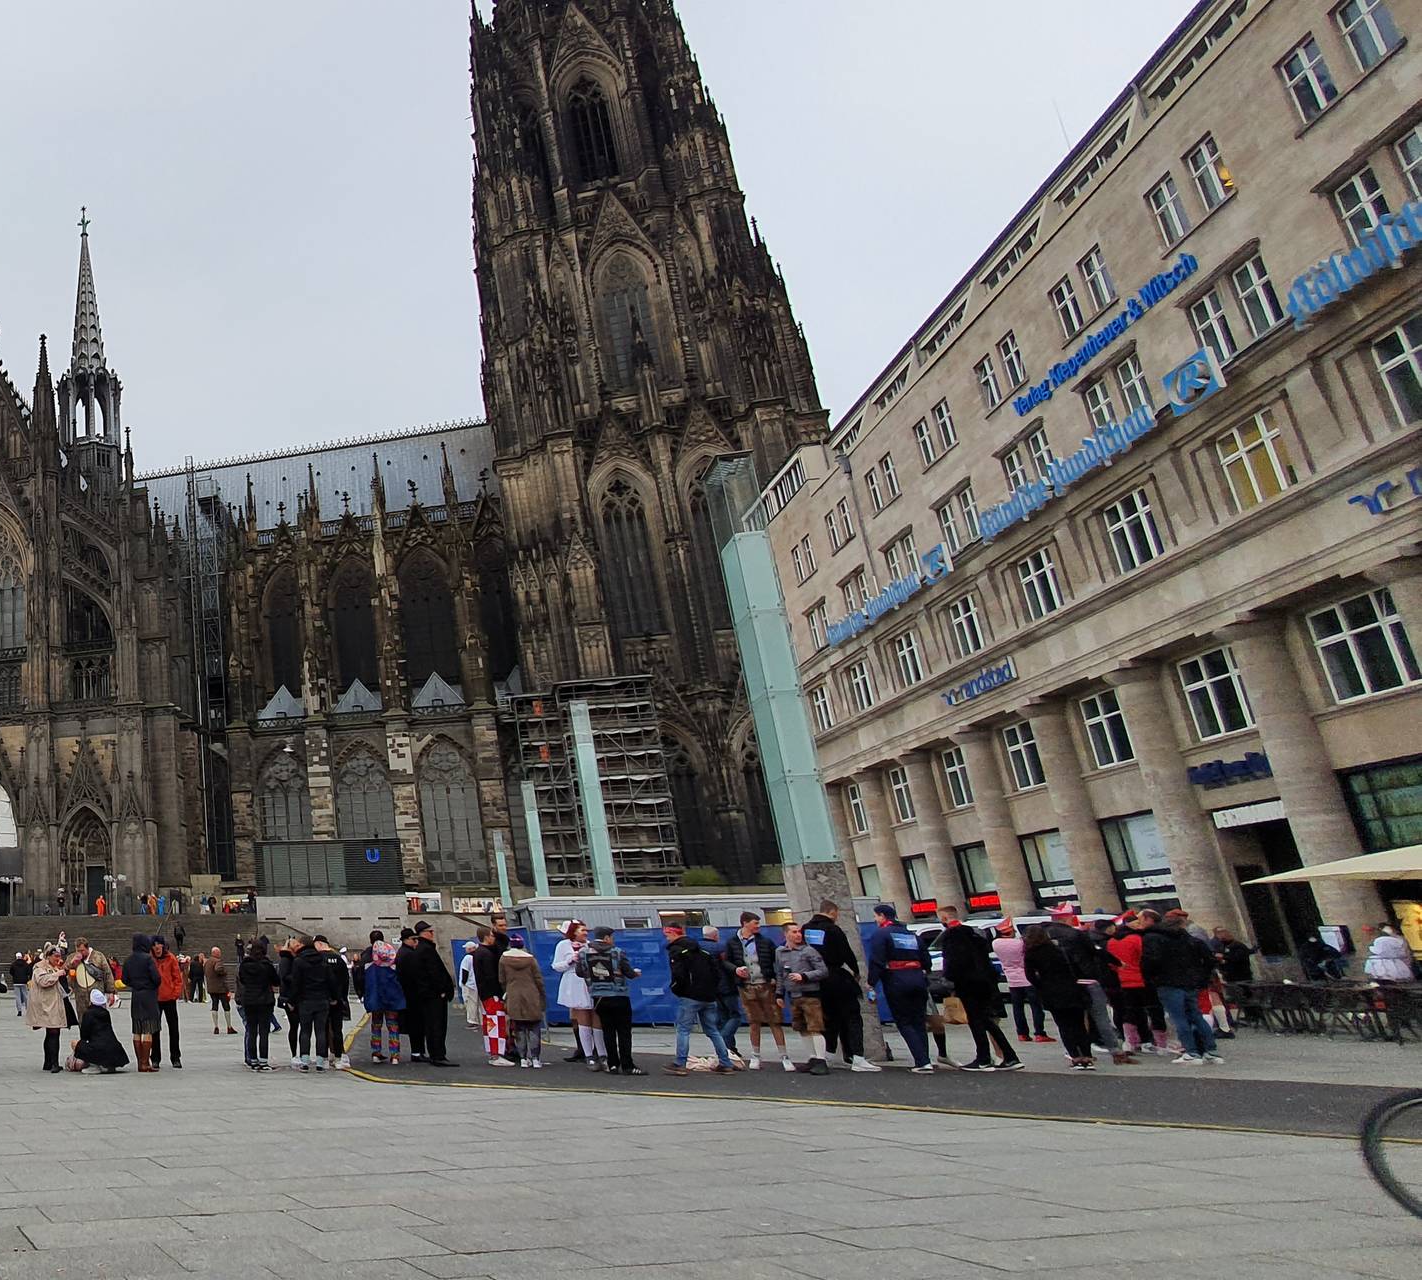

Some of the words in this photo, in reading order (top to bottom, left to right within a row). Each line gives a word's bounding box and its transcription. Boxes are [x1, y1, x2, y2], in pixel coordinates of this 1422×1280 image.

[1012, 379, 1053, 417] Verlag
[1048, 311, 1128, 389] Kiepenheuer
[1127, 298, 1144, 322] &
[1139, 252, 1199, 308] Witsch
[366, 848, 380, 863] U
